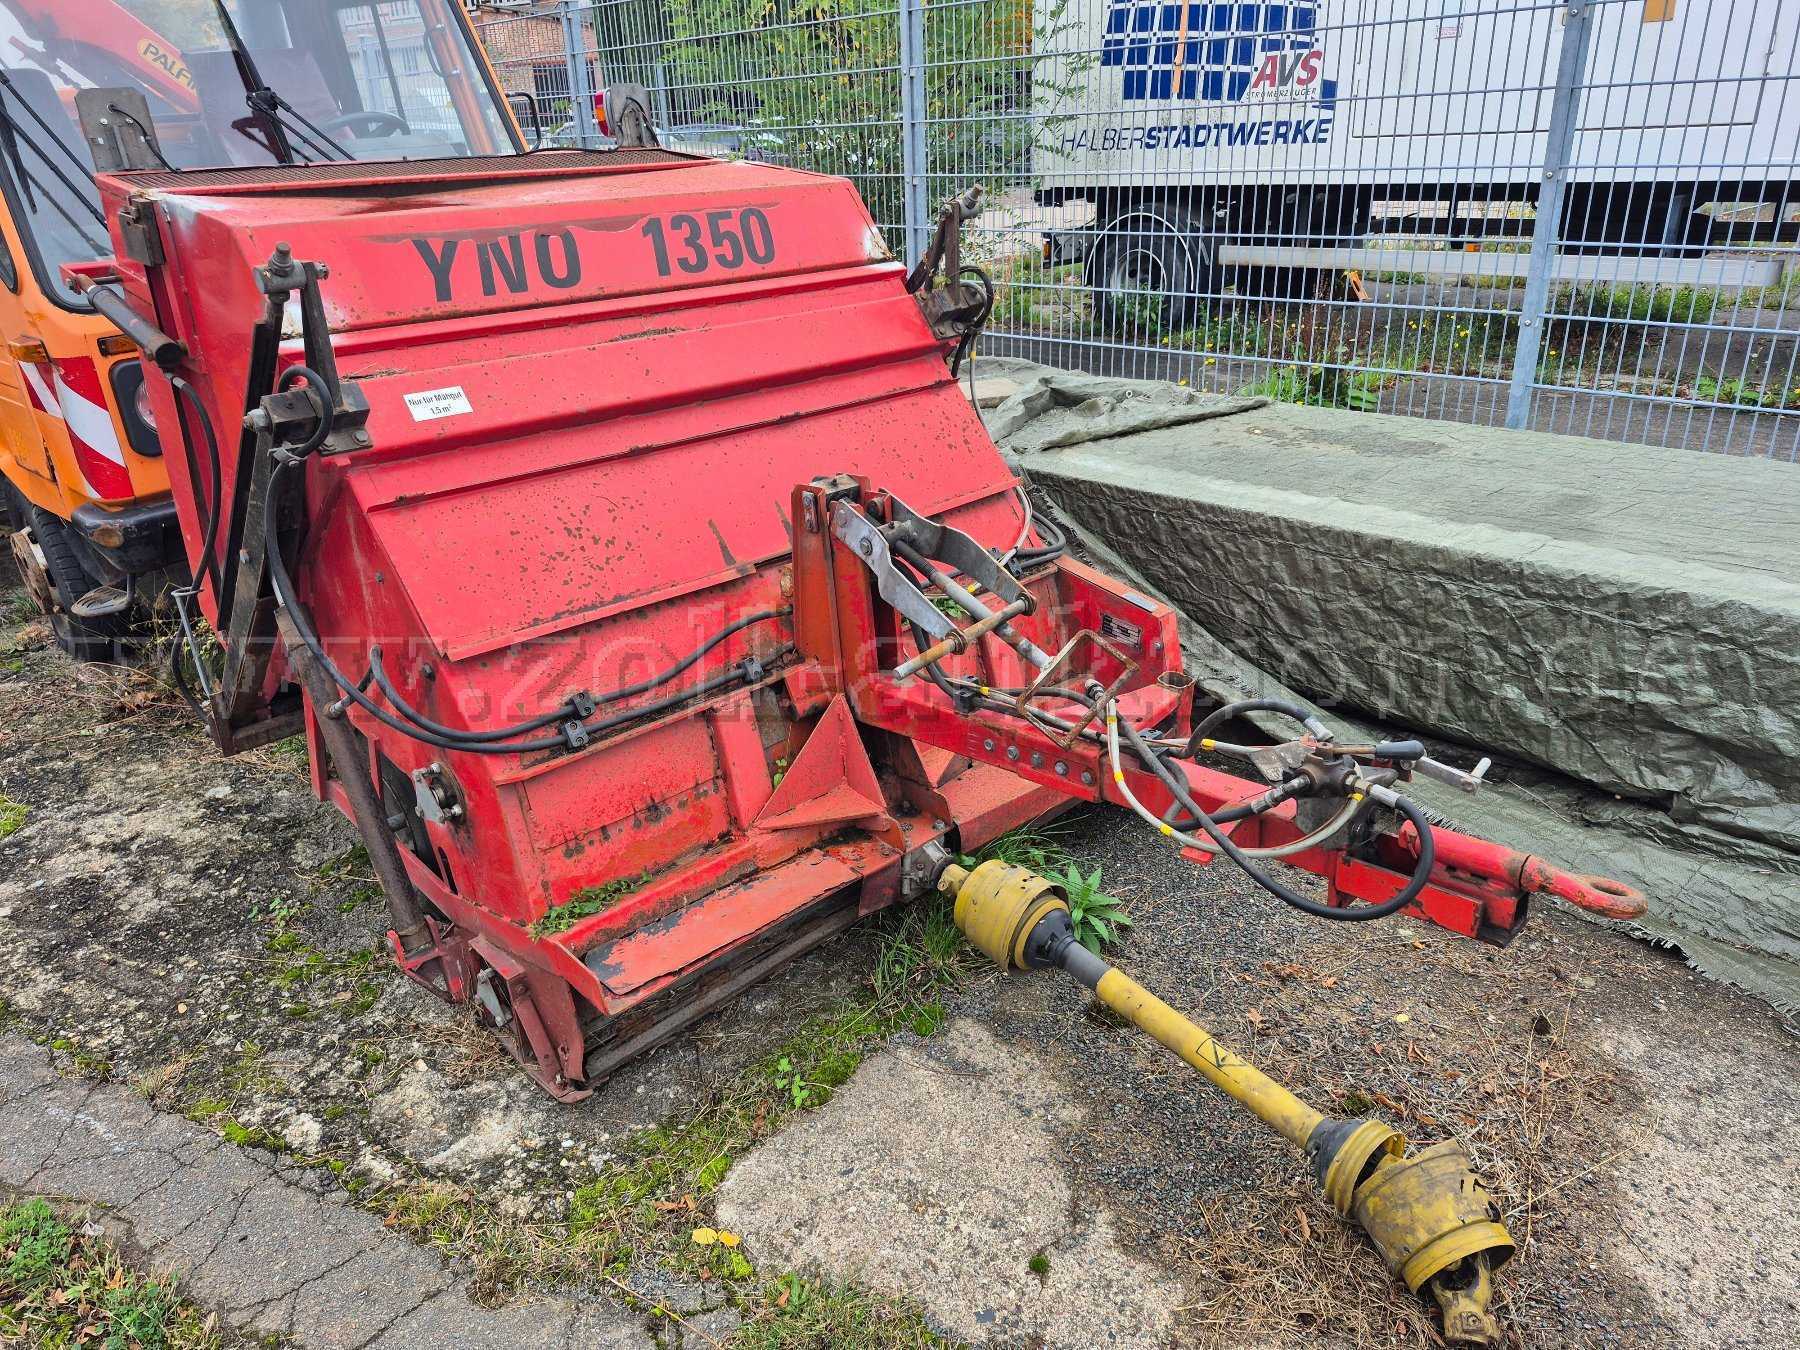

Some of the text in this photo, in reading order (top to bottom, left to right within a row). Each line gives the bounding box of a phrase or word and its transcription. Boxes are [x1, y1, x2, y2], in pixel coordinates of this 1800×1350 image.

[1251, 50, 1323, 89] AVS
[1060, 118, 1332, 151] HALBERSTADTWERKE
[411, 206, 776, 302] YNO 1350
[408, 391, 463, 407] Nur für Mähgut
